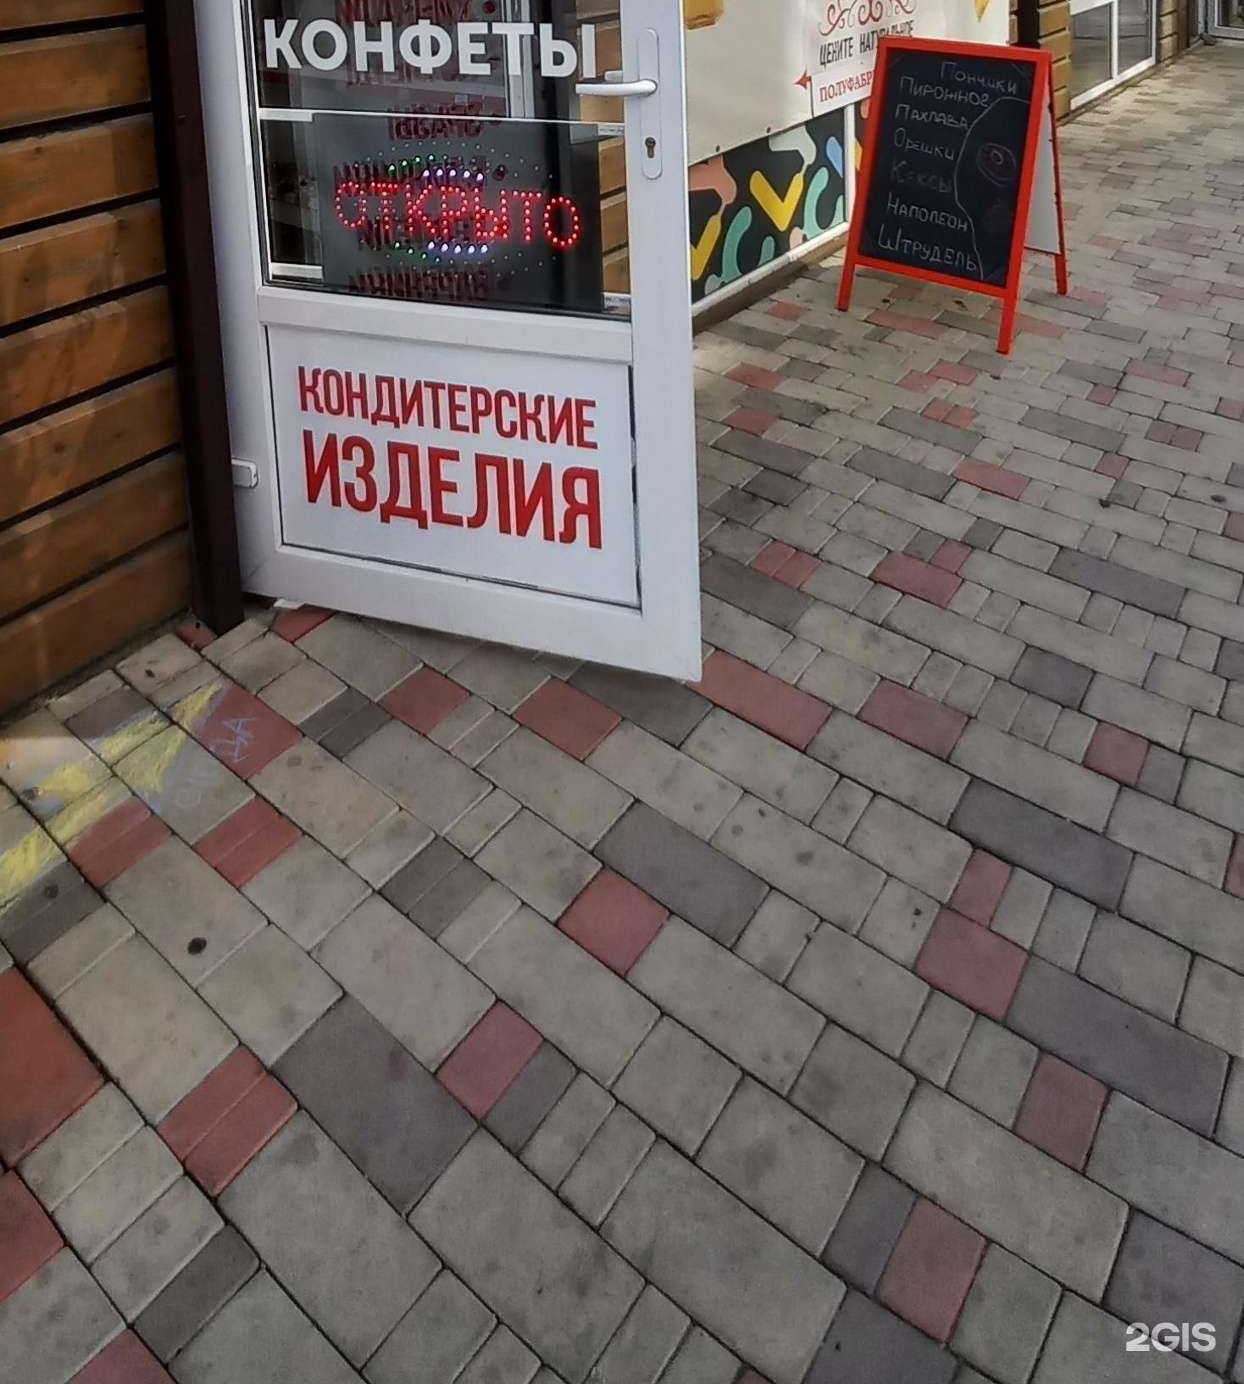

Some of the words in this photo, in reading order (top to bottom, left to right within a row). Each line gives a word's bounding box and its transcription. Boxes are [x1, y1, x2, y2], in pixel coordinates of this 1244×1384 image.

[263, 18, 597, 78] КОНФЕТЫ
[820, 37, 853, 72] ЦЕНИТЕ
[820, 70, 874, 103] ПОЛУФАБР
[334, 178, 583, 251] ОТКРЫТО
[298, 365, 599, 450] КОНДИТЕРСКИЕ
[303, 429, 603, 551] ИЗДЕЛИЯ
